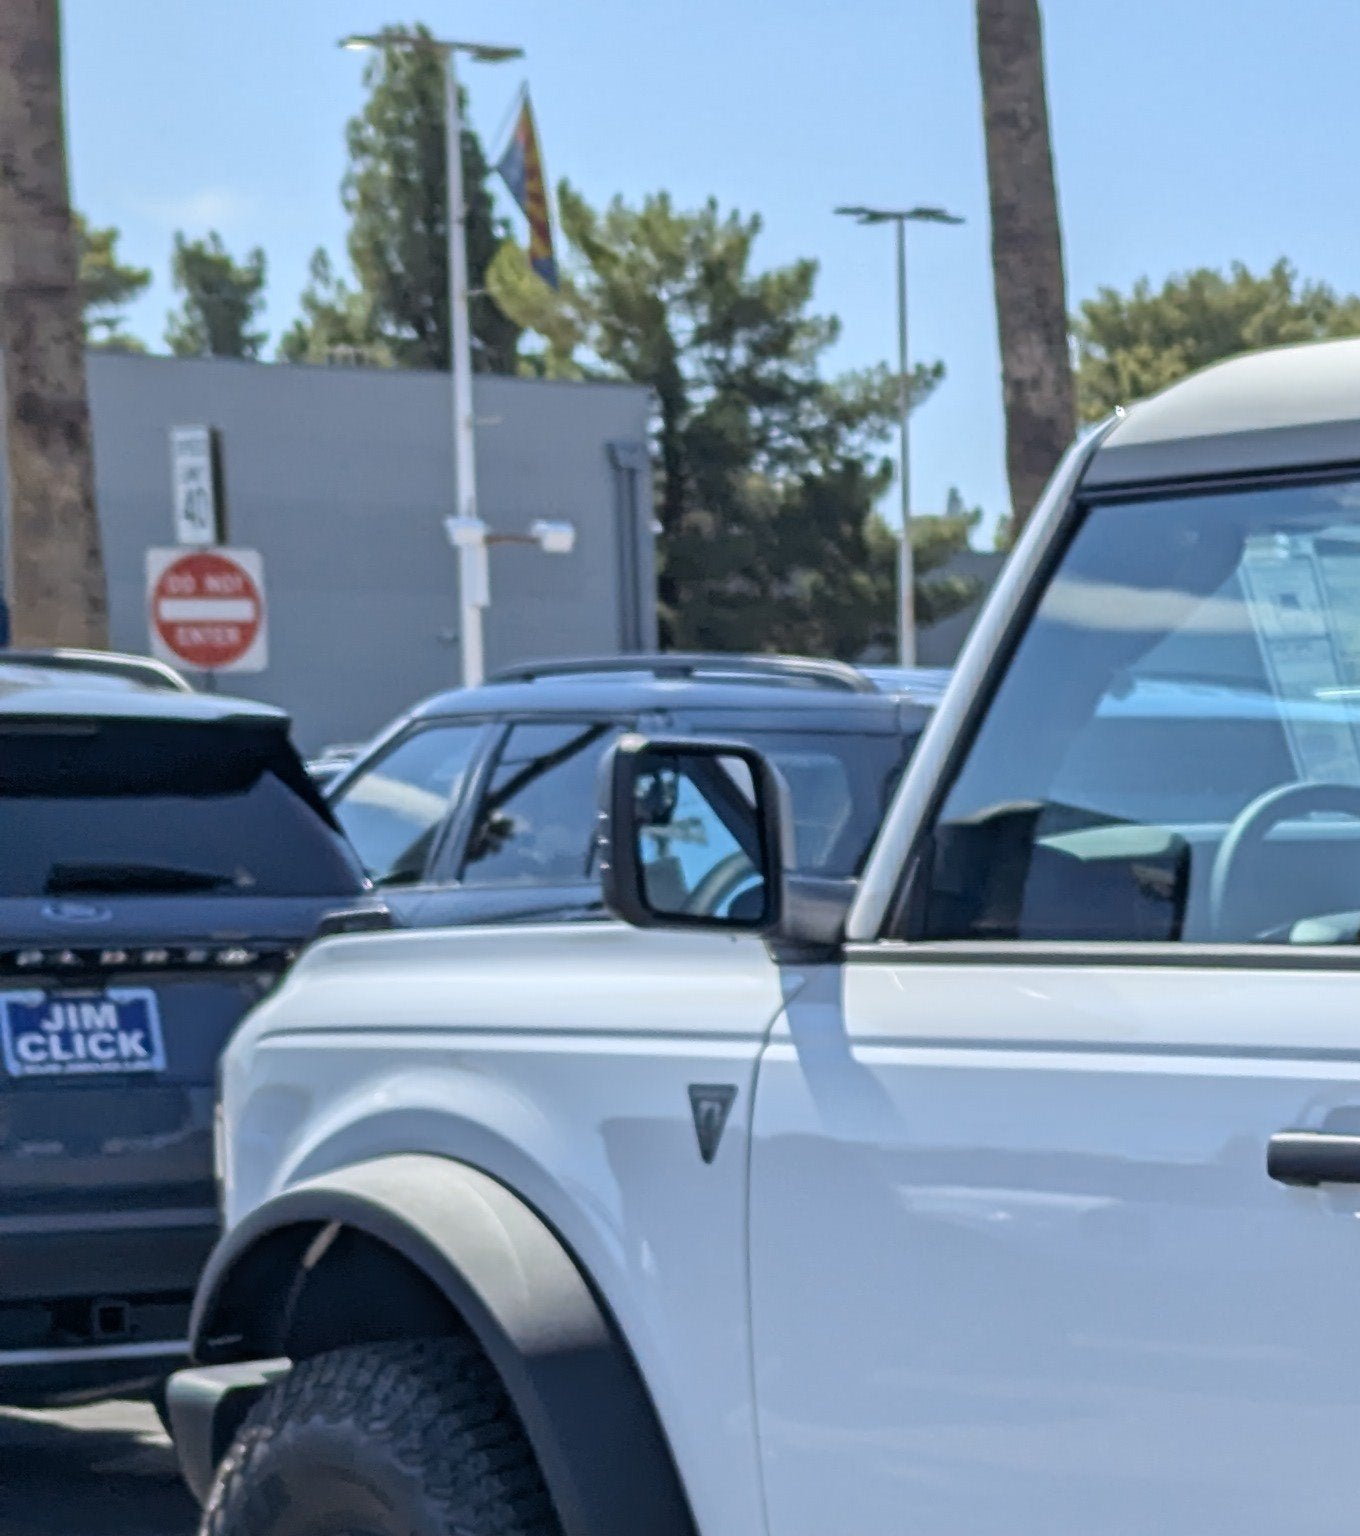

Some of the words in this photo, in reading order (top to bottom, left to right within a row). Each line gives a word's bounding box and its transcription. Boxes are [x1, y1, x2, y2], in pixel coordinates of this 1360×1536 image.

[168, 574, 196, 594] DO
[204, 573, 243, 593] NOT
[176, 625, 241, 647] ENTER
[40, 1002, 119, 1032] JIM
[17, 1030, 150, 1062] CLICK
